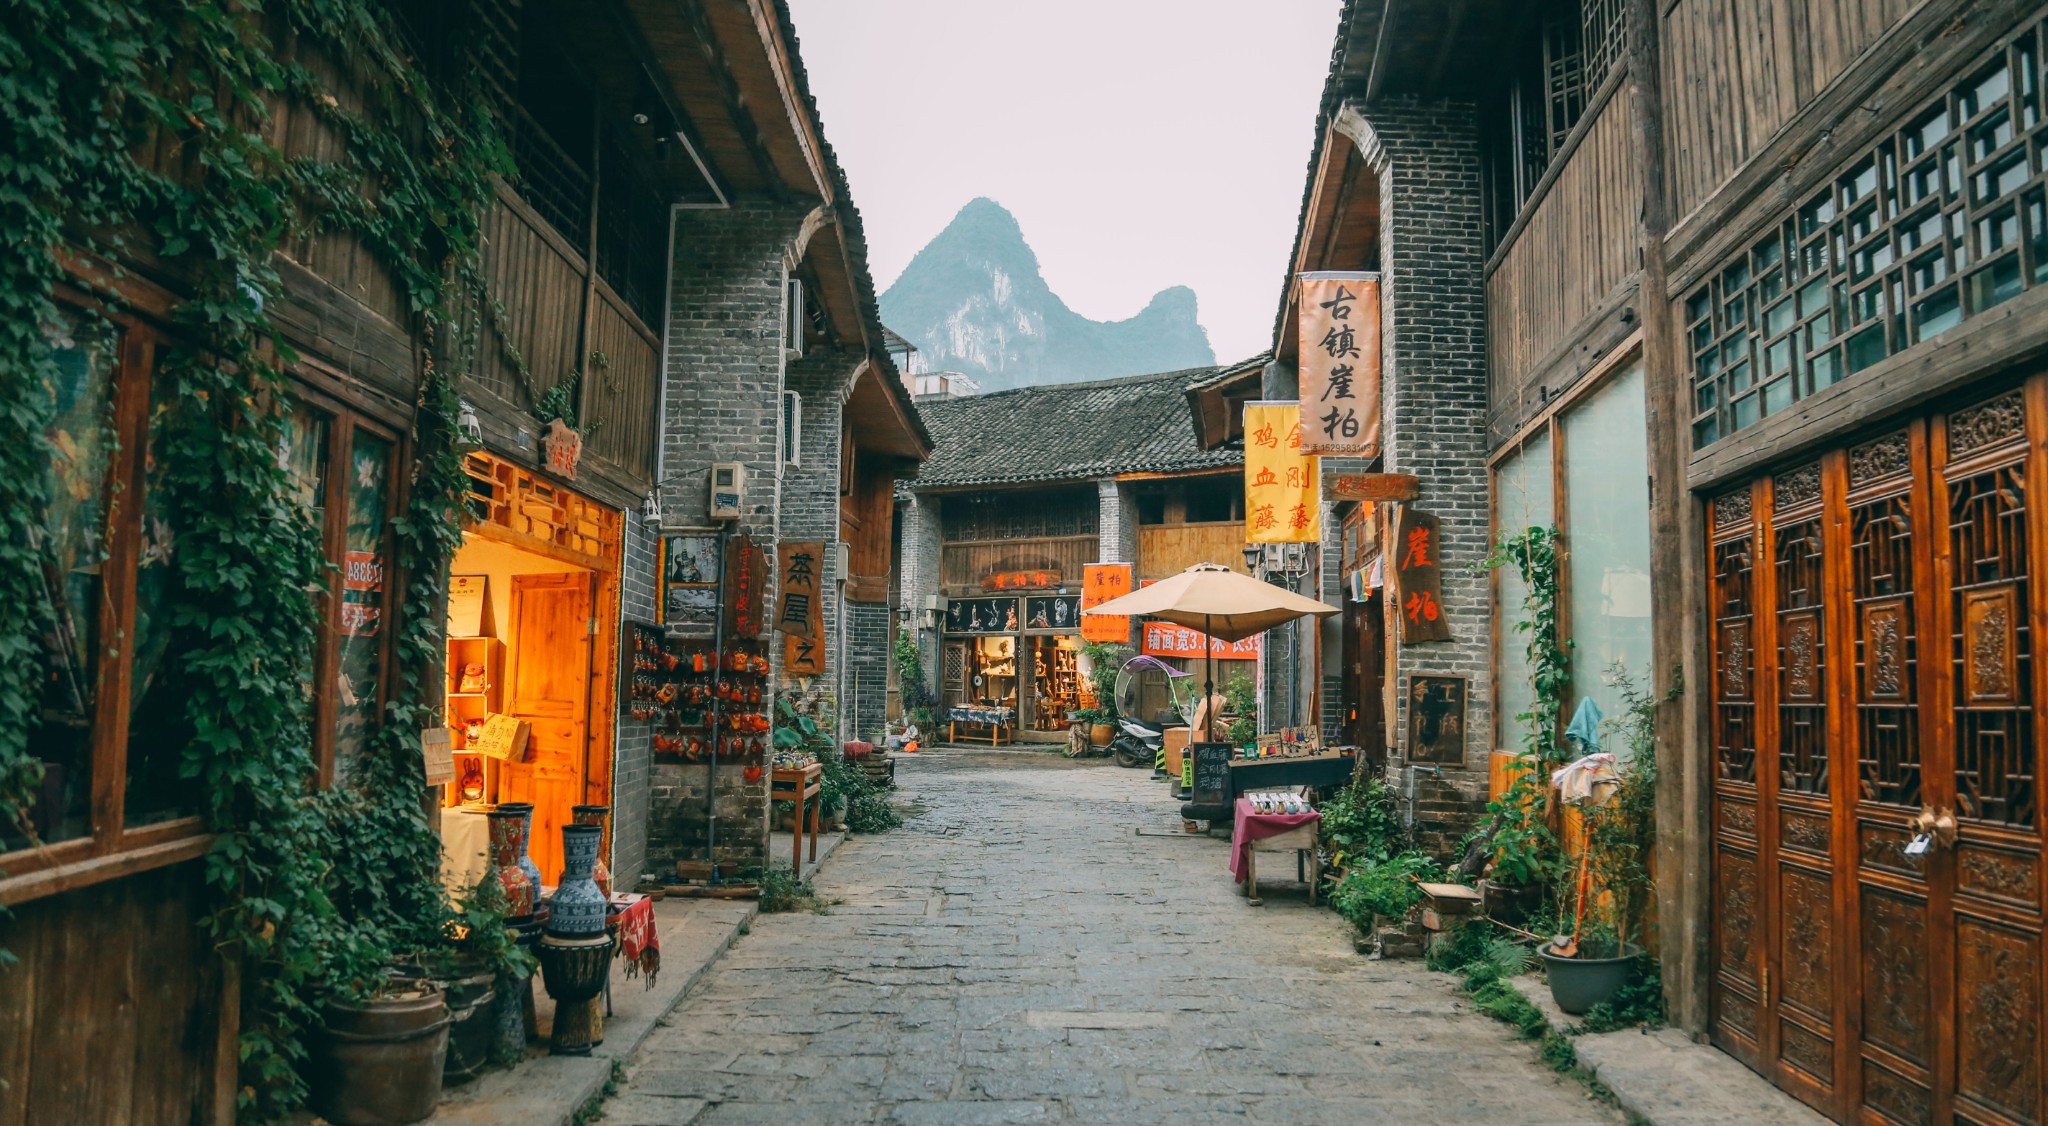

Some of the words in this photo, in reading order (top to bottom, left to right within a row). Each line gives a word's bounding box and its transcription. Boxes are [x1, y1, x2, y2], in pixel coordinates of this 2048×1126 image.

[1251, 421, 1279, 530] 鸡血藤
[1401, 526, 1438, 625] 崖柏
